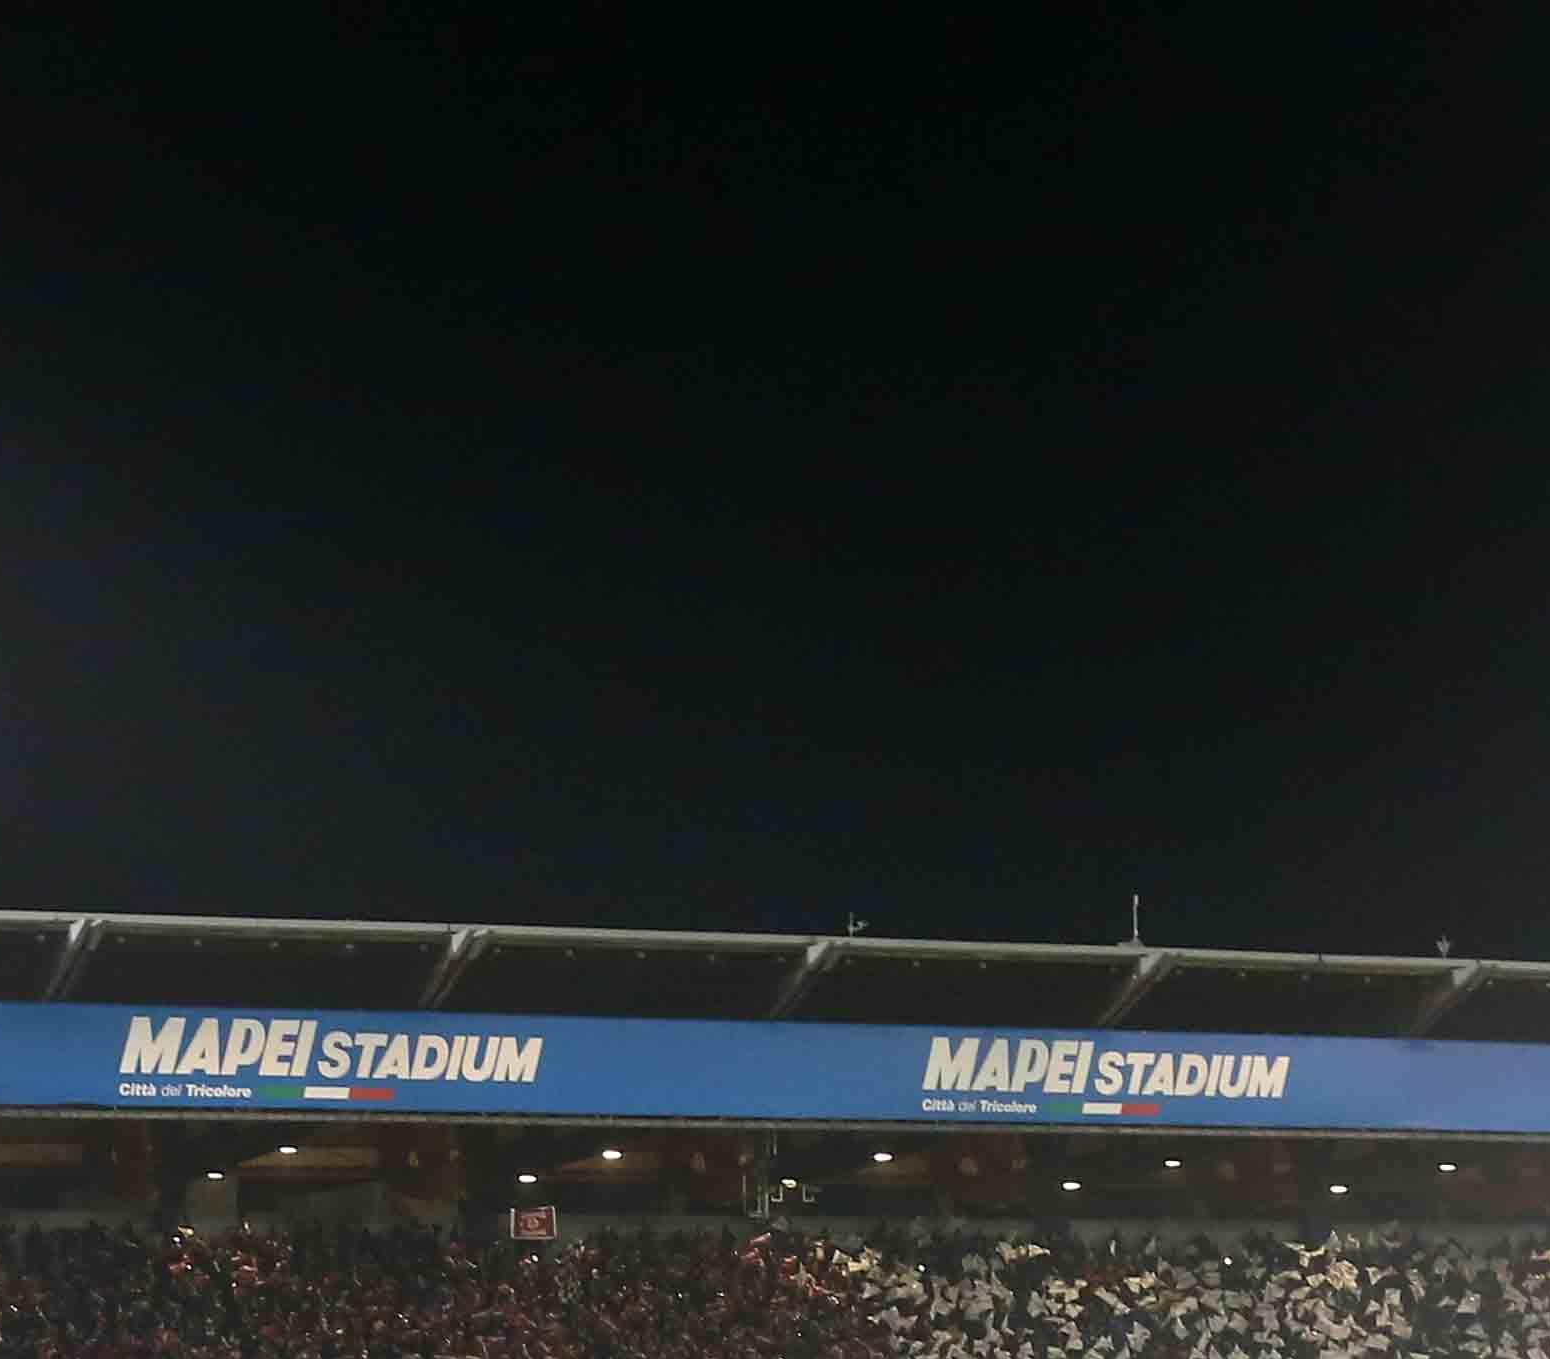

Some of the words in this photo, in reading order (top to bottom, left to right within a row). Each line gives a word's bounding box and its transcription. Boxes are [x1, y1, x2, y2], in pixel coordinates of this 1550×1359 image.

[119, 1015, 318, 1077] MAPEI
[317, 1030, 544, 1084] STADIUM
[922, 1036, 1095, 1094] MAPEI
[1093, 1051, 1290, 1099] STADIUM
[119, 1083, 157, 1098] Città
[186, 1083, 252, 1099] Tricolore
[922, 1099, 955, 1113] Città
[980, 1100, 1037, 1114] Tricolore
